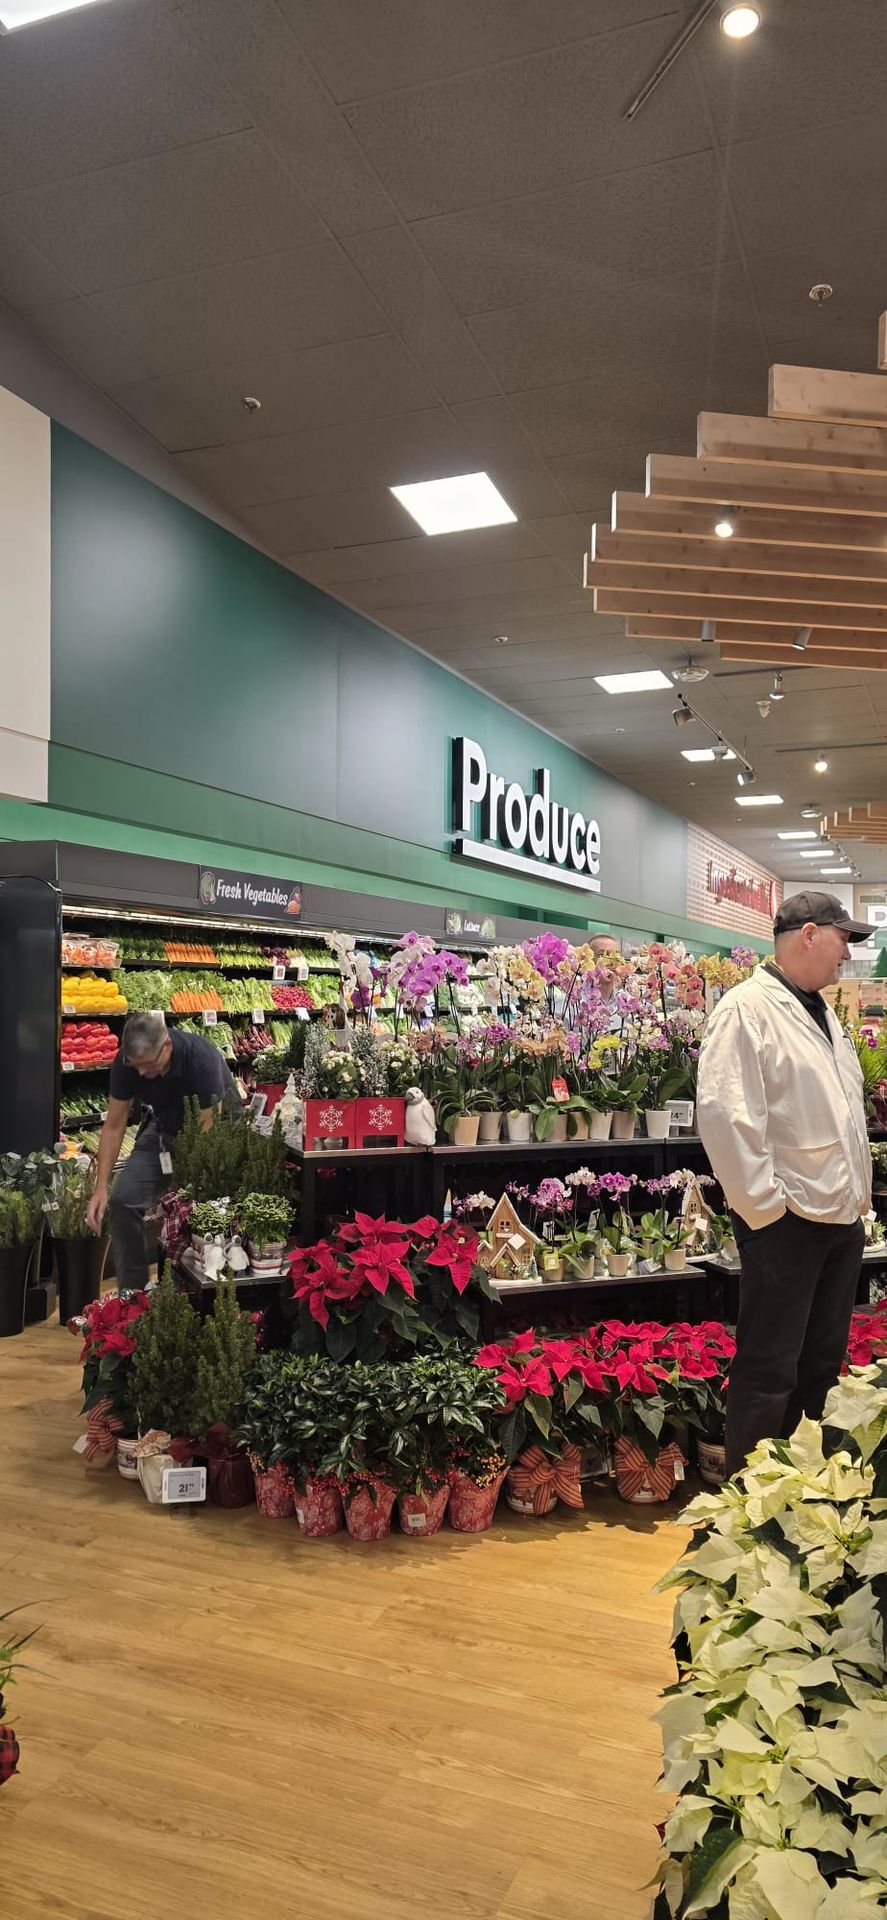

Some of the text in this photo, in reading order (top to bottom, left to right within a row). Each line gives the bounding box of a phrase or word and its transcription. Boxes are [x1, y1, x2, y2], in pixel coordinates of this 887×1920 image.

[455, 737, 601, 875] Produce
[216, 879, 288, 906] Fresh Vegetables
